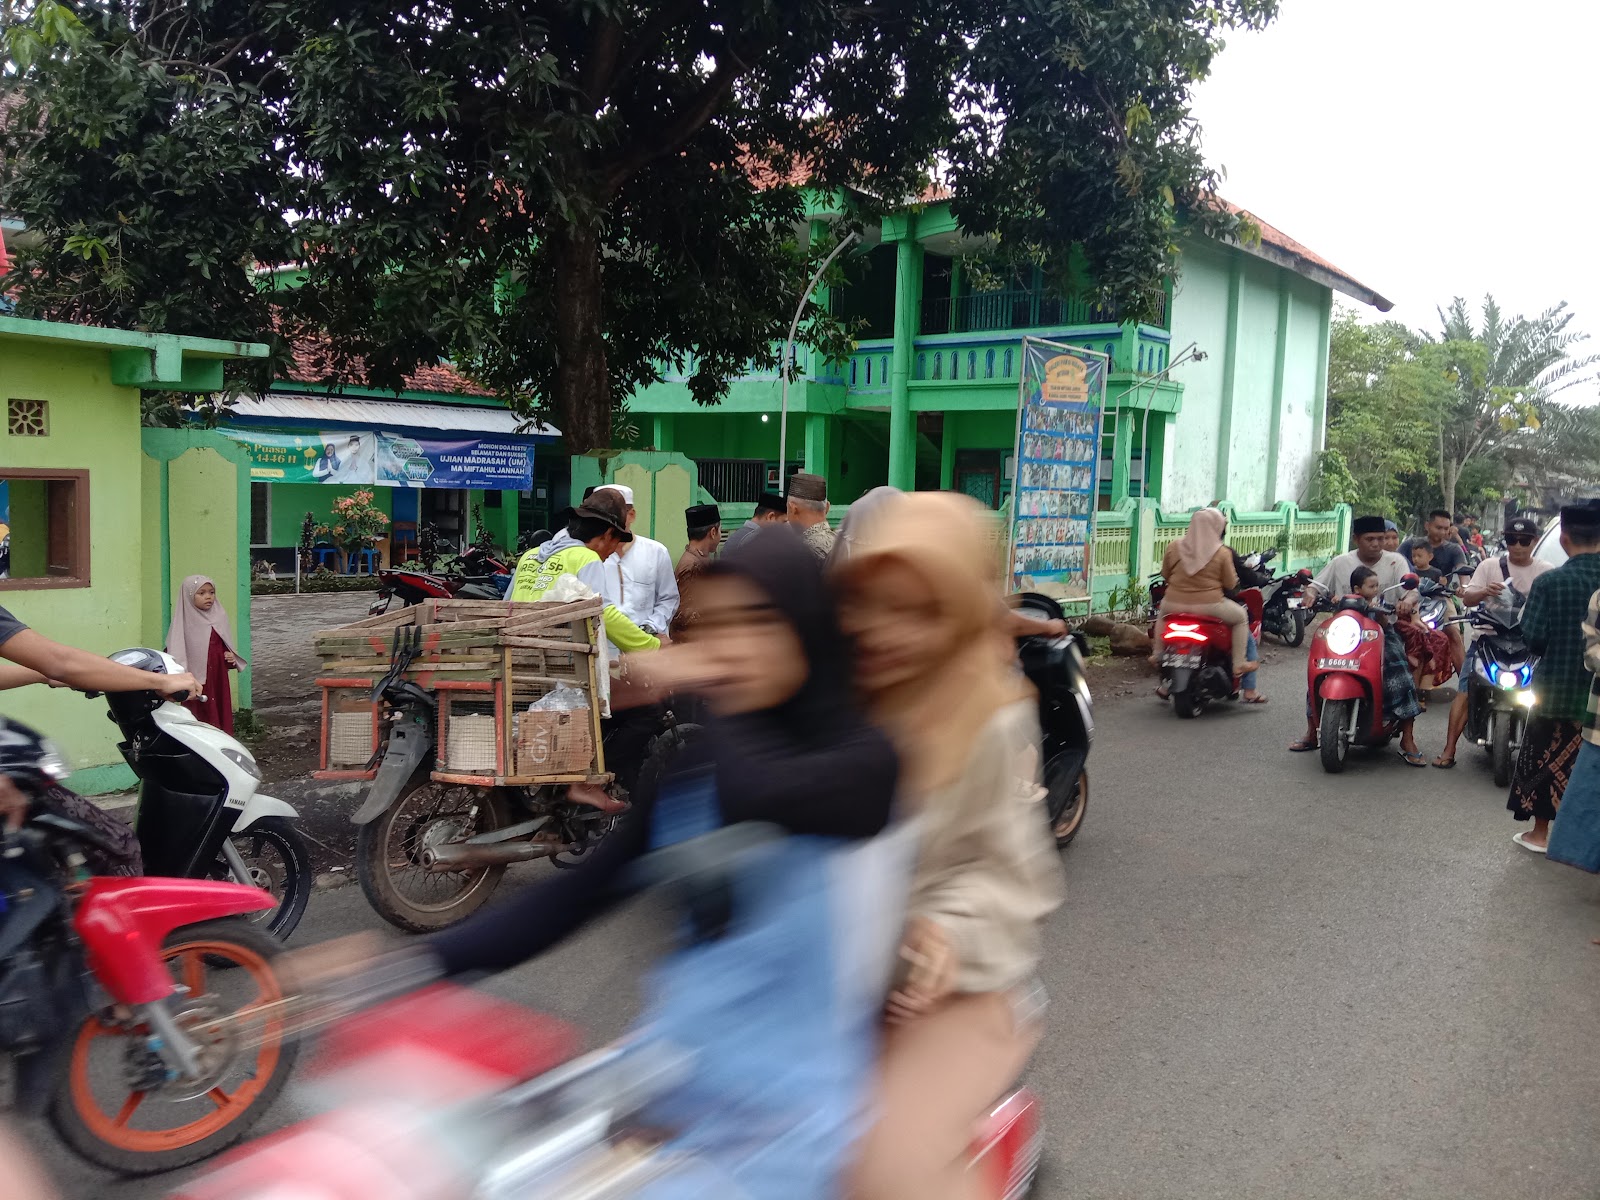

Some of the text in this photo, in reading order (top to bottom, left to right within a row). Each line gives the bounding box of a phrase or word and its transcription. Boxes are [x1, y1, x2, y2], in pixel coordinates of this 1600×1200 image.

[254, 443, 287, 454] Puasa
[257, 454, 285, 463] 1446
[288, 455, 297, 464] H
[440, 455, 526, 467] UJIAN MADRASAH (UM)
[463, 465, 496, 473] MIFTAHUL
[497, 466, 525, 475] JANNAH
[1328, 658, 1347, 666] 6666
[229, 798, 246, 806] YAMAHA
